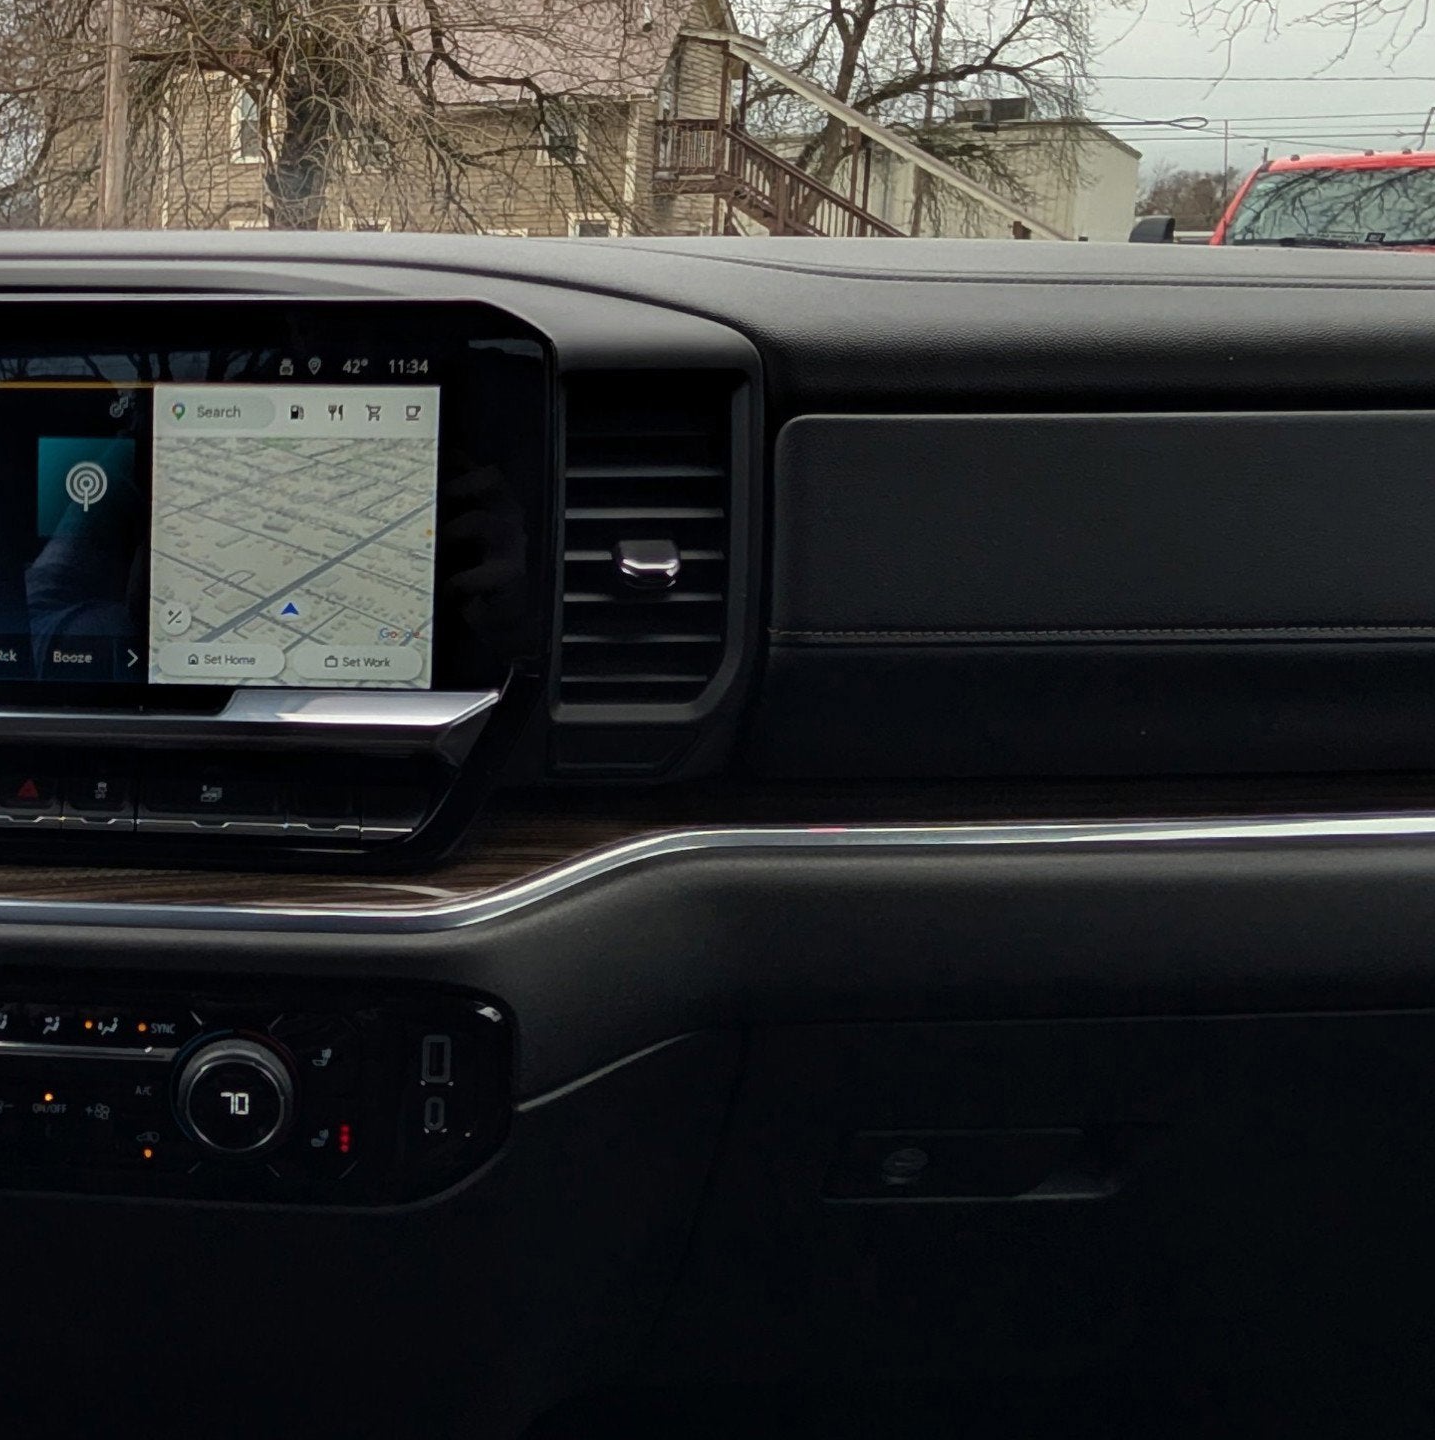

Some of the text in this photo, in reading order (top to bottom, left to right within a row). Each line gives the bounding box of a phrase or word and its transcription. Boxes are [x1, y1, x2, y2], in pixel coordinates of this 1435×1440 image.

[388, 360, 429, 375] 11:34
[196, 405, 241, 419] Search
[52, 650, 93, 664] Booze
[203, 653, 256, 667] Set Home
[342, 656, 391, 669] Set Work
[150, 1022, 177, 1036] SYNC
[220, 1092, 250, 1115] 70
